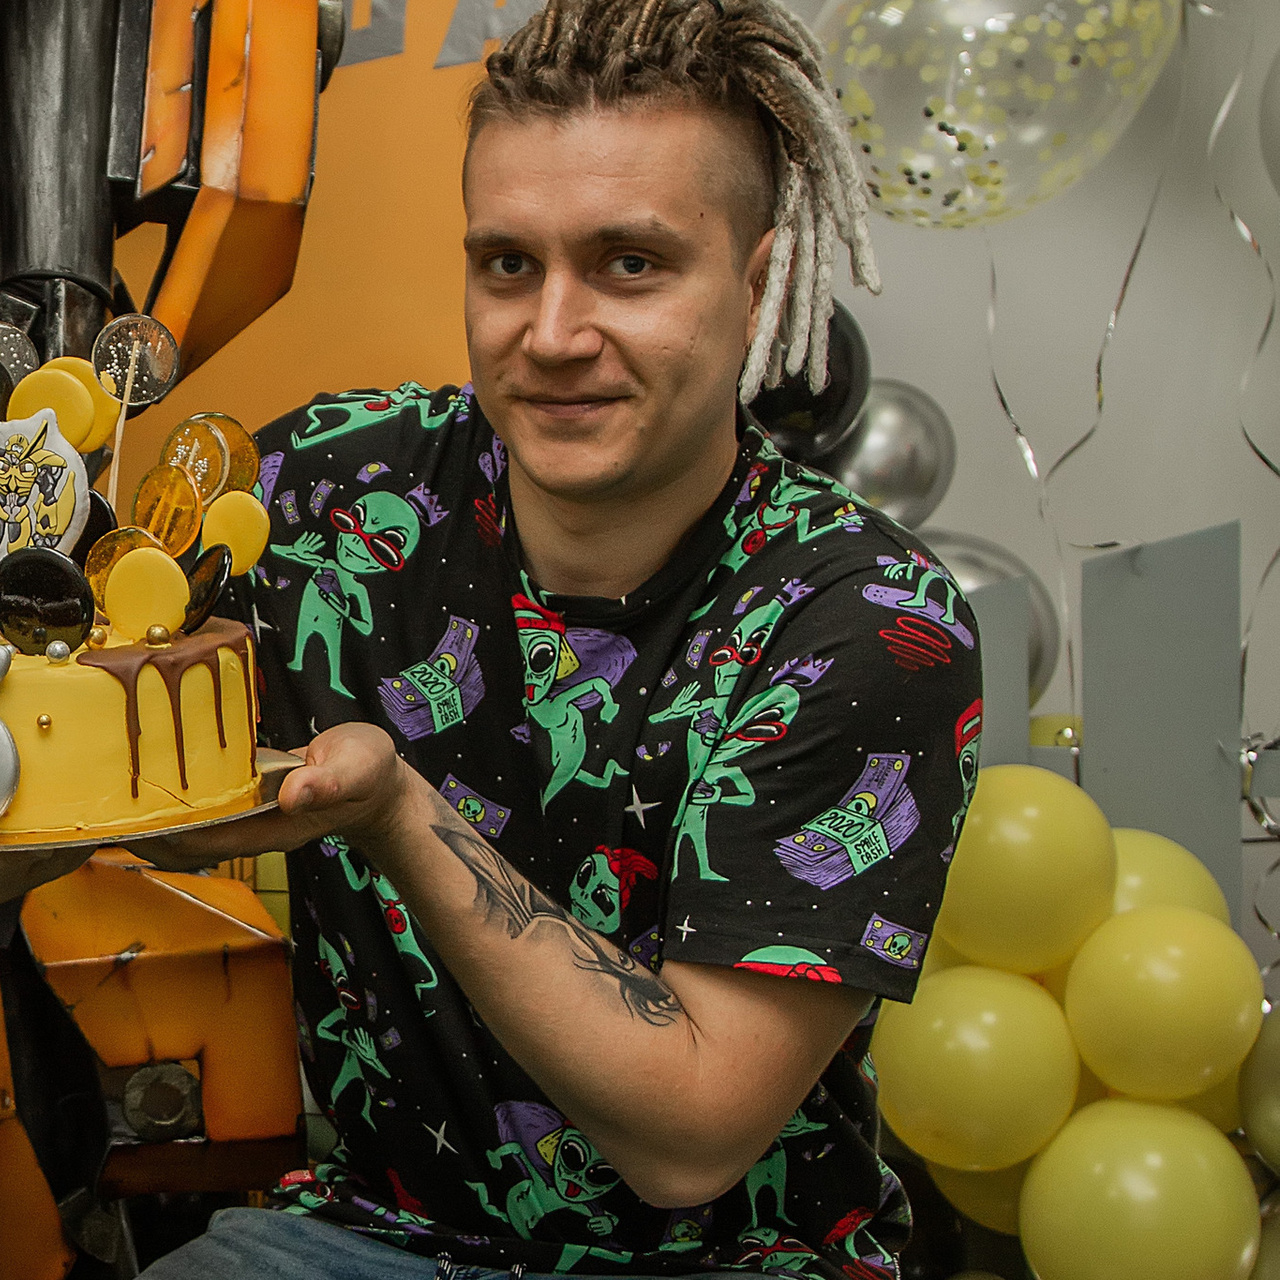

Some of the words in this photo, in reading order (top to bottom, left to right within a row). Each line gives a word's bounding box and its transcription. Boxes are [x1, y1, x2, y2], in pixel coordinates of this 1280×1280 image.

[410, 666, 447, 695] 2020
[440, 708, 460, 726] CASH
[816, 811, 865, 838] 2020
[861, 845, 885, 866] CASH
